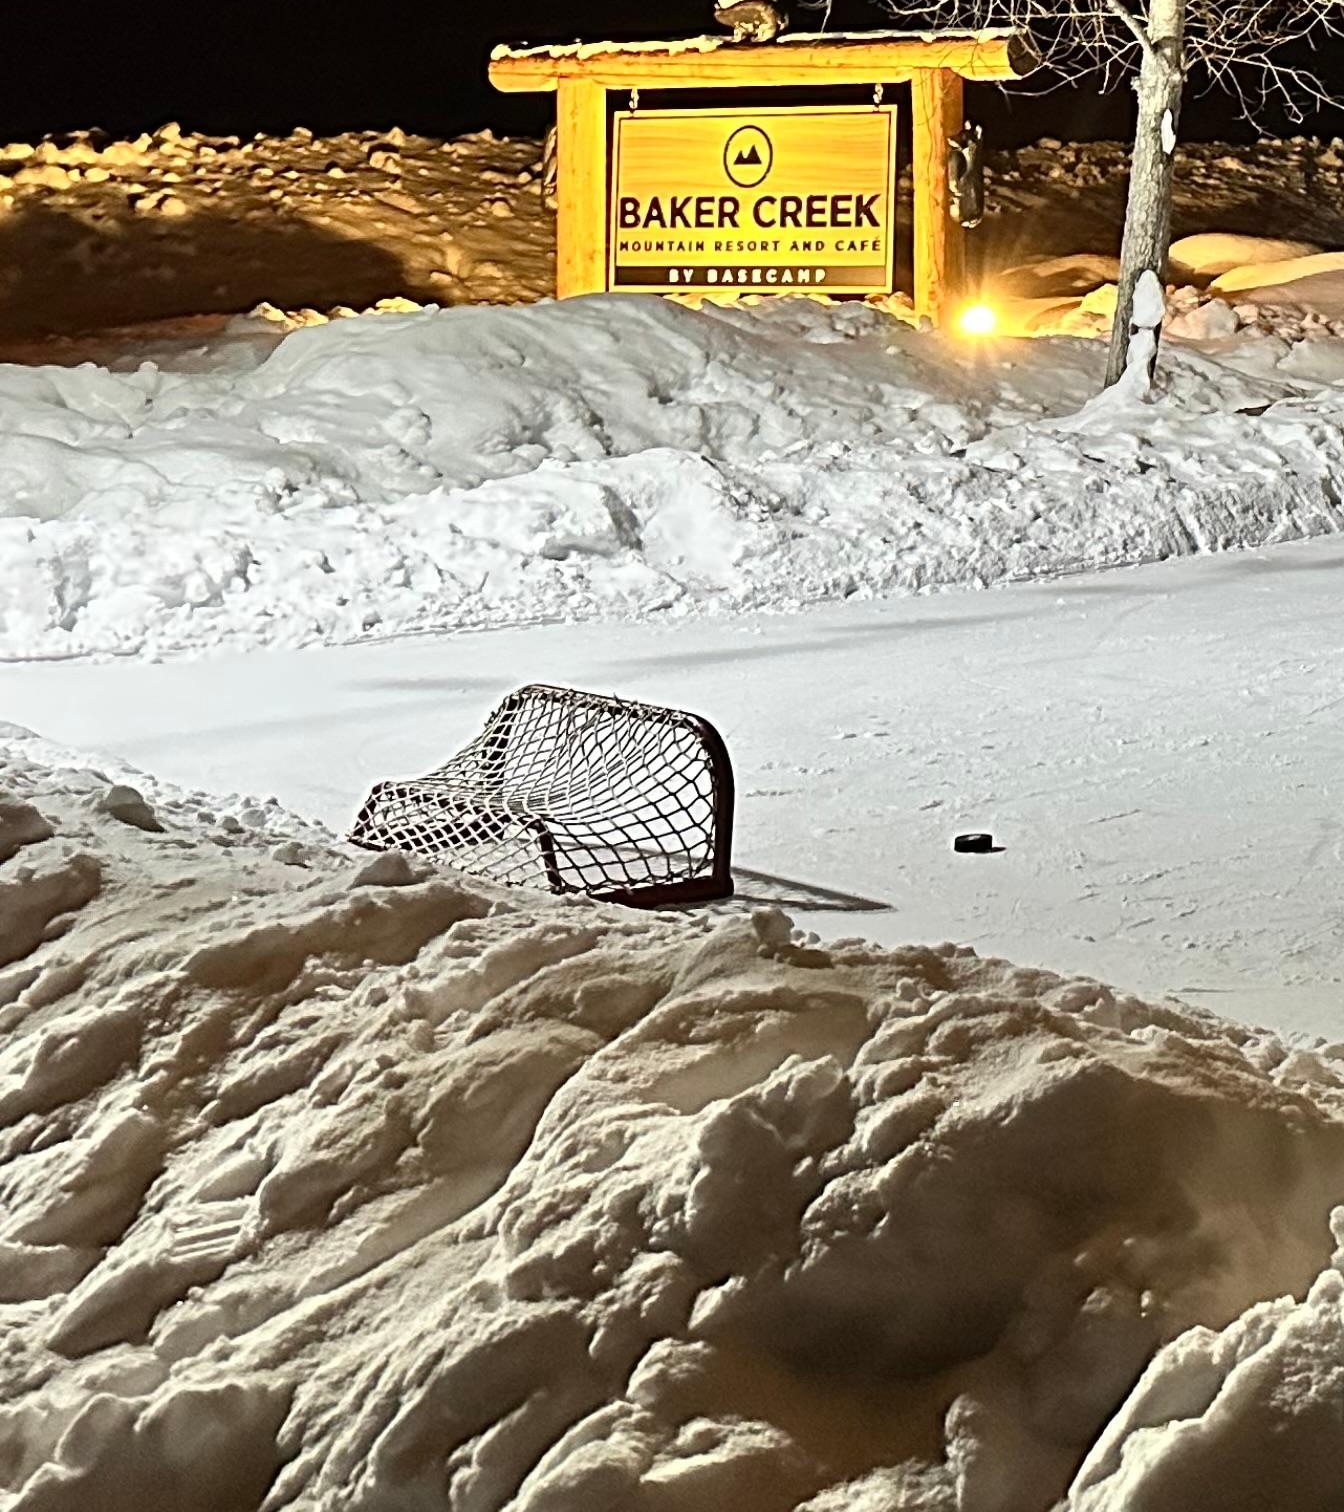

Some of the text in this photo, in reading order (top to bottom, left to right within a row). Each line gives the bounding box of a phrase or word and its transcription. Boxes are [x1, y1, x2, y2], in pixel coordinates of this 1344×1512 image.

[619, 193, 882, 229] BAKER CREEK
[619, 236, 882, 252] MOUNTAIN RESORT AND CAFÉ
[668, 268, 827, 283] BY BASECAMP
